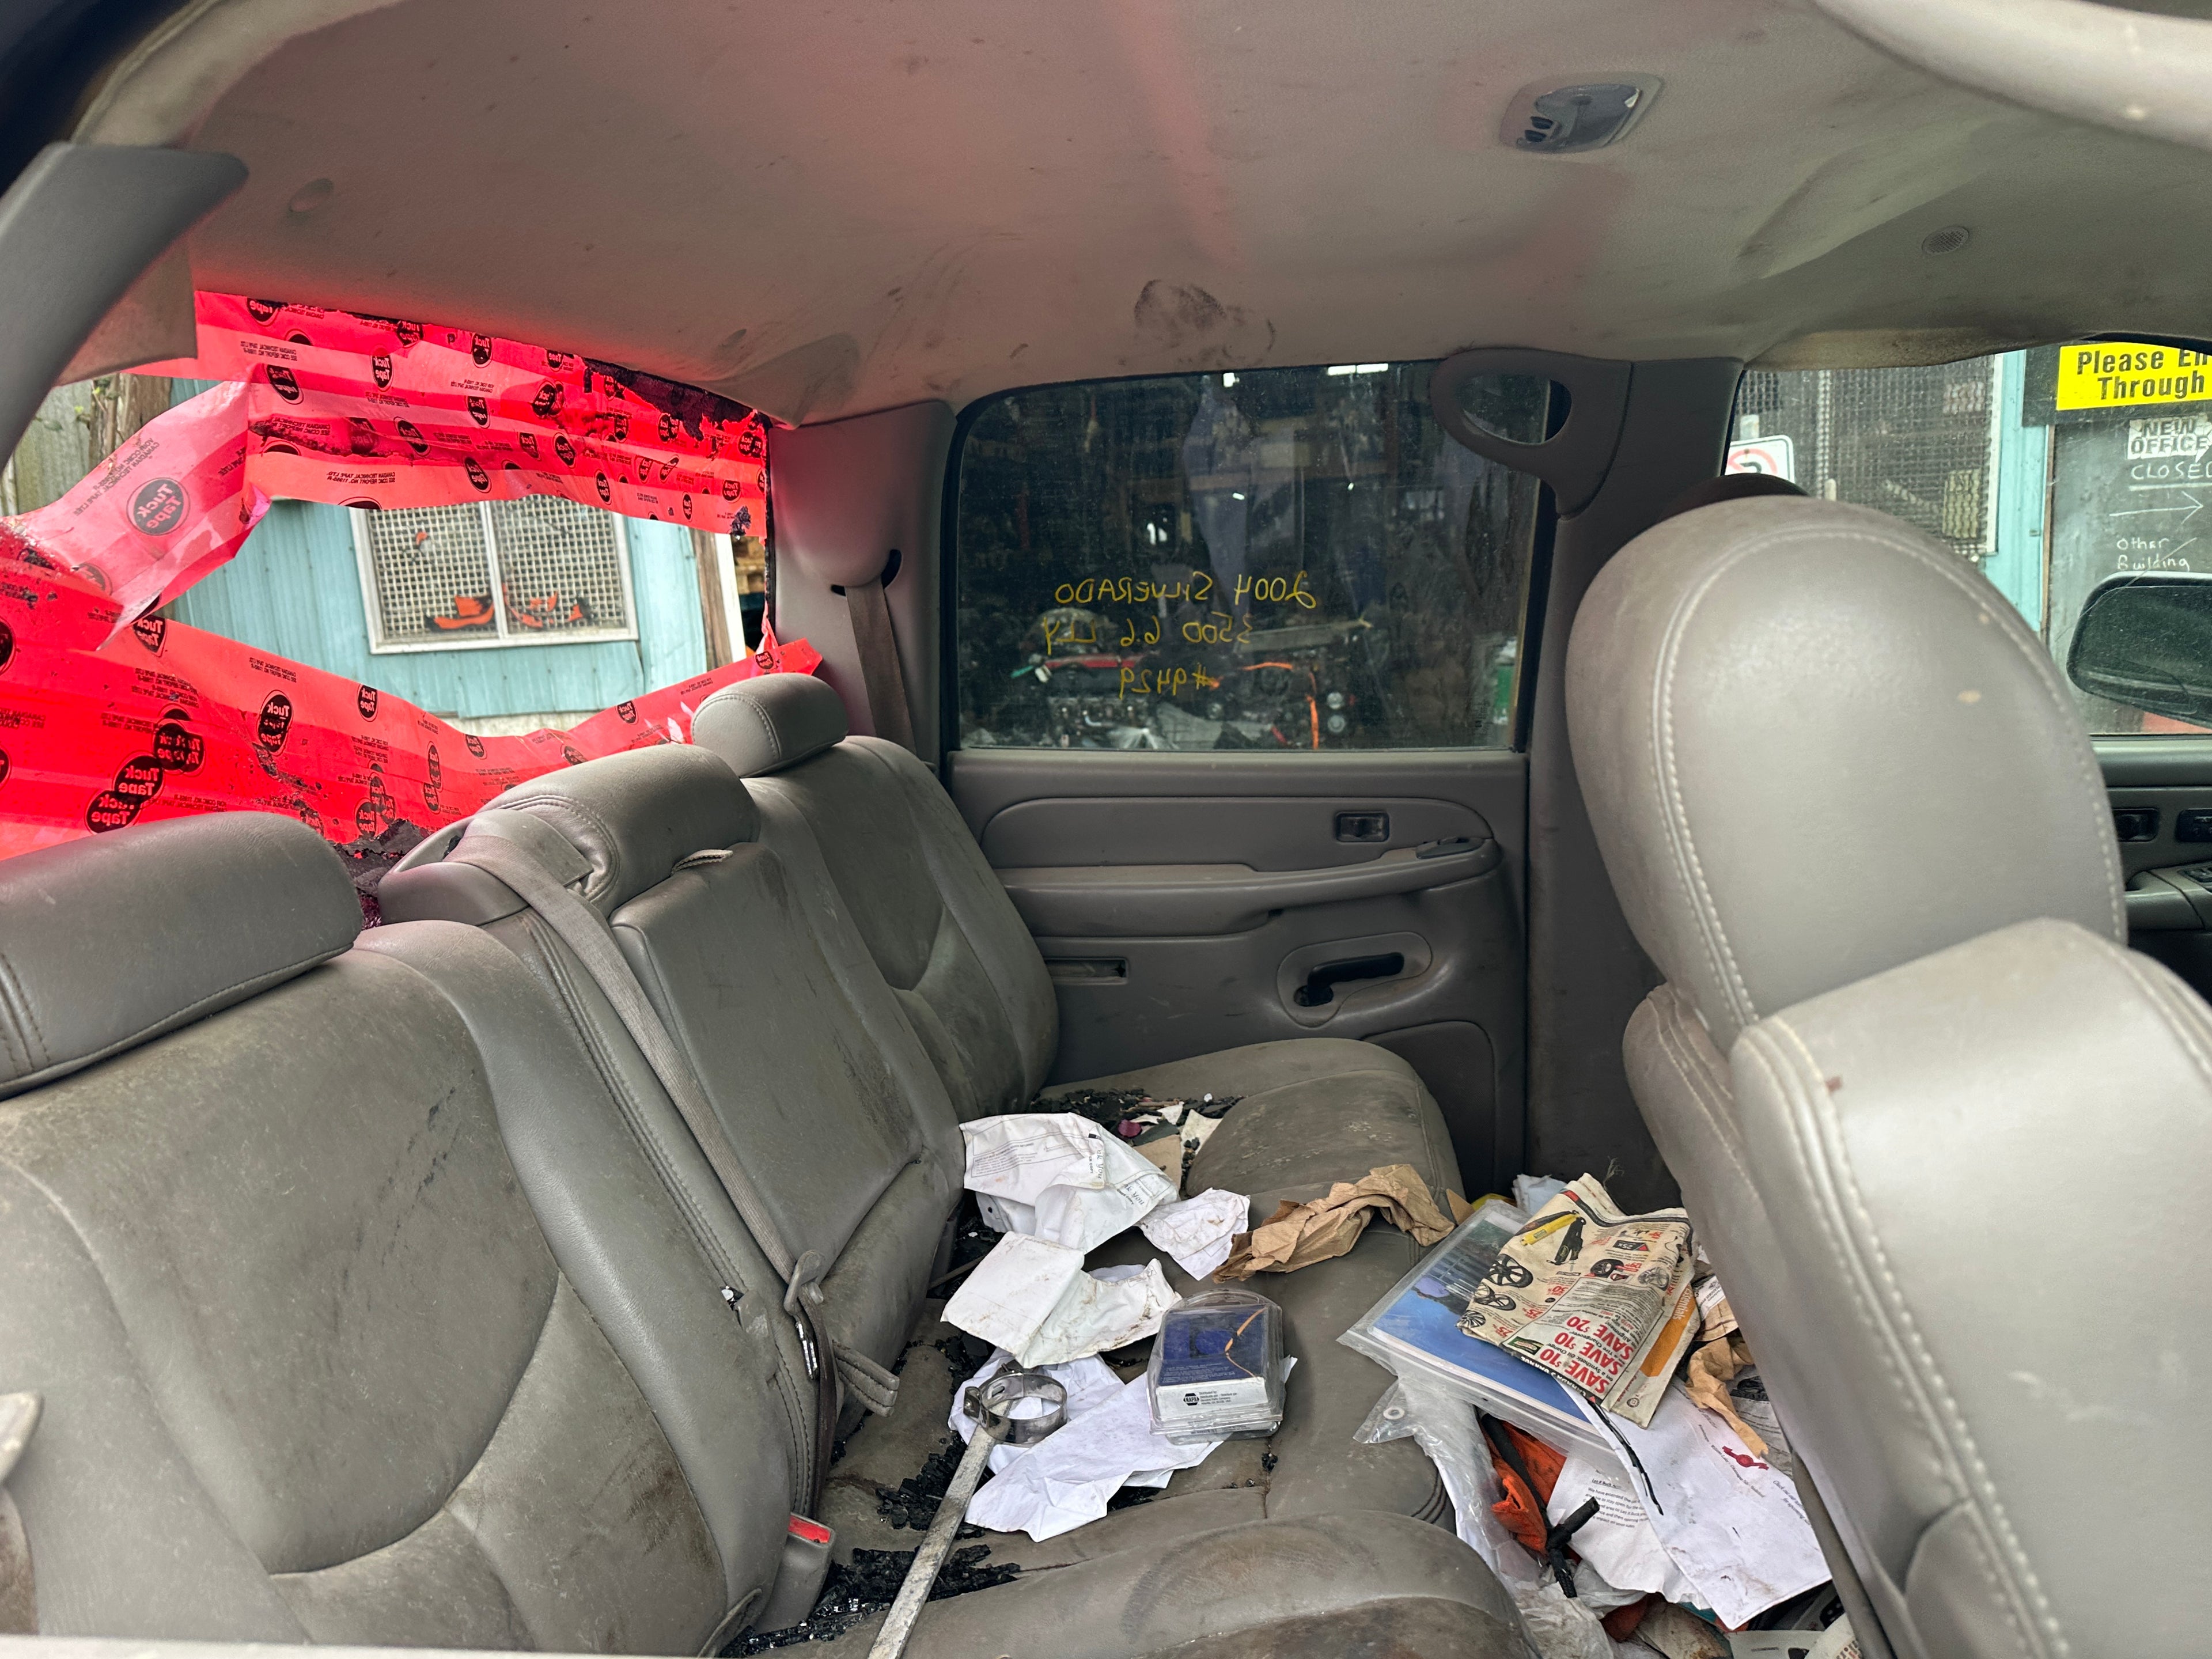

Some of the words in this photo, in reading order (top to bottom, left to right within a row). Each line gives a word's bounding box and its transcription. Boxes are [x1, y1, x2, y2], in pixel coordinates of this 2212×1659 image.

[2077, 351, 2164, 375] Please
[2097, 370, 2205, 399] Through
[2142, 419, 2195, 435] NEW
[2131, 435, 2209, 454] OFFICE
[2117, 537, 2169, 550] Other
[2118, 554, 2190, 572] Building
[1095, 1162, 1106, 1179] You
[1130, 1191, 1146, 1206] You
[1566, 1316, 1590, 1333] $20
[1554, 1332, 1576, 1350] $10
[1592, 1323, 1634, 1361] SAVE
[1539, 1349, 1562, 1368] $10
[1578, 1342, 1623, 1376] SAVE
[1603, 1347, 1613, 1356] Tire
[1576, 1355, 1601, 1374] Synthetic
[1564, 1359, 1609, 1394] SAVE
[1184, 1393, 1199, 1404] NAPA
